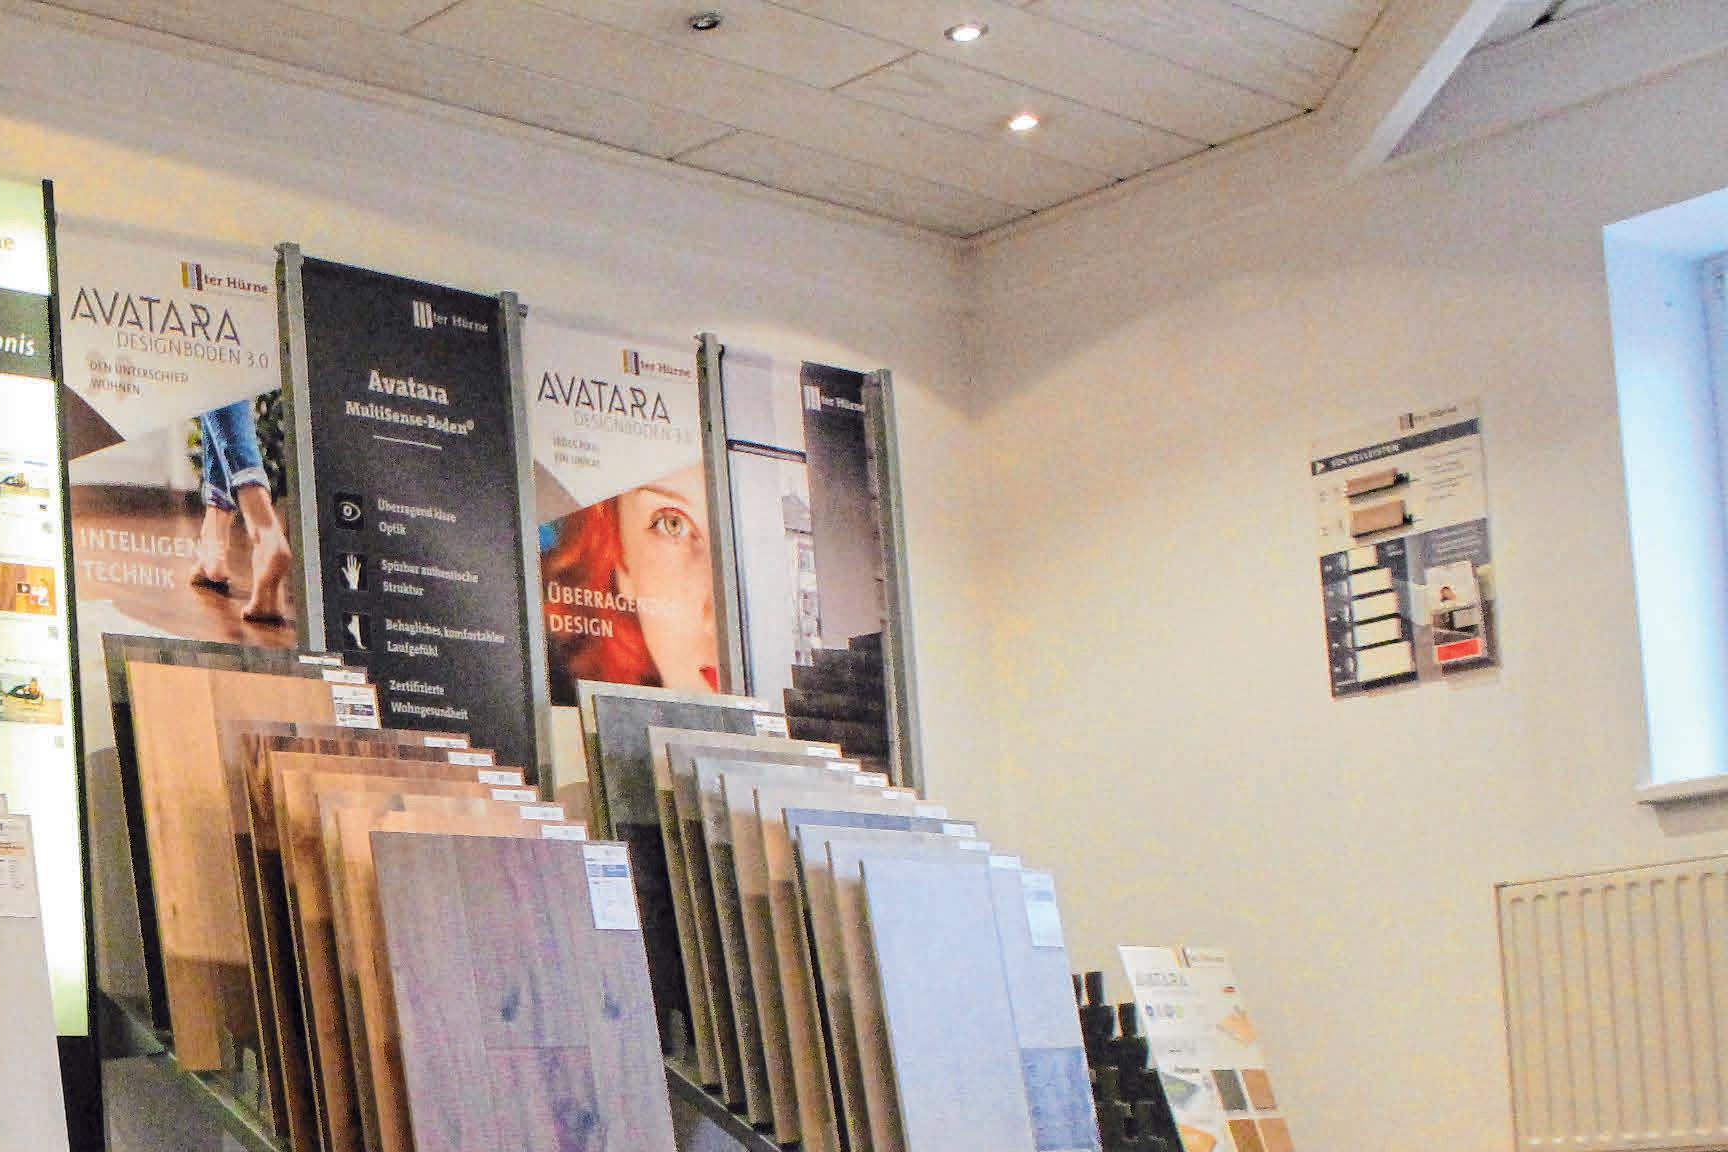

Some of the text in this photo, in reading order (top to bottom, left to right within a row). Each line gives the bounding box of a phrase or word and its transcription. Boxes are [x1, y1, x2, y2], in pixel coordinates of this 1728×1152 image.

[204, 273, 268, 294] ter Hürne
[70, 287, 241, 346] AVATARA
[116, 331, 240, 365] DESIGNBODEN
[368, 369, 449, 406] Avatara
[537, 371, 671, 424] AVATARA
[379, 522, 407, 536] Optik
[81, 560, 176, 588] TECHNIK
[383, 581, 424, 597] Struktur
[549, 614, 615, 638] DESIGN
[387, 641, 439, 658] Laufgefühl
[389, 680, 445, 695] Zertifizierte
[391, 702, 469, 720] Wohngesundheit
